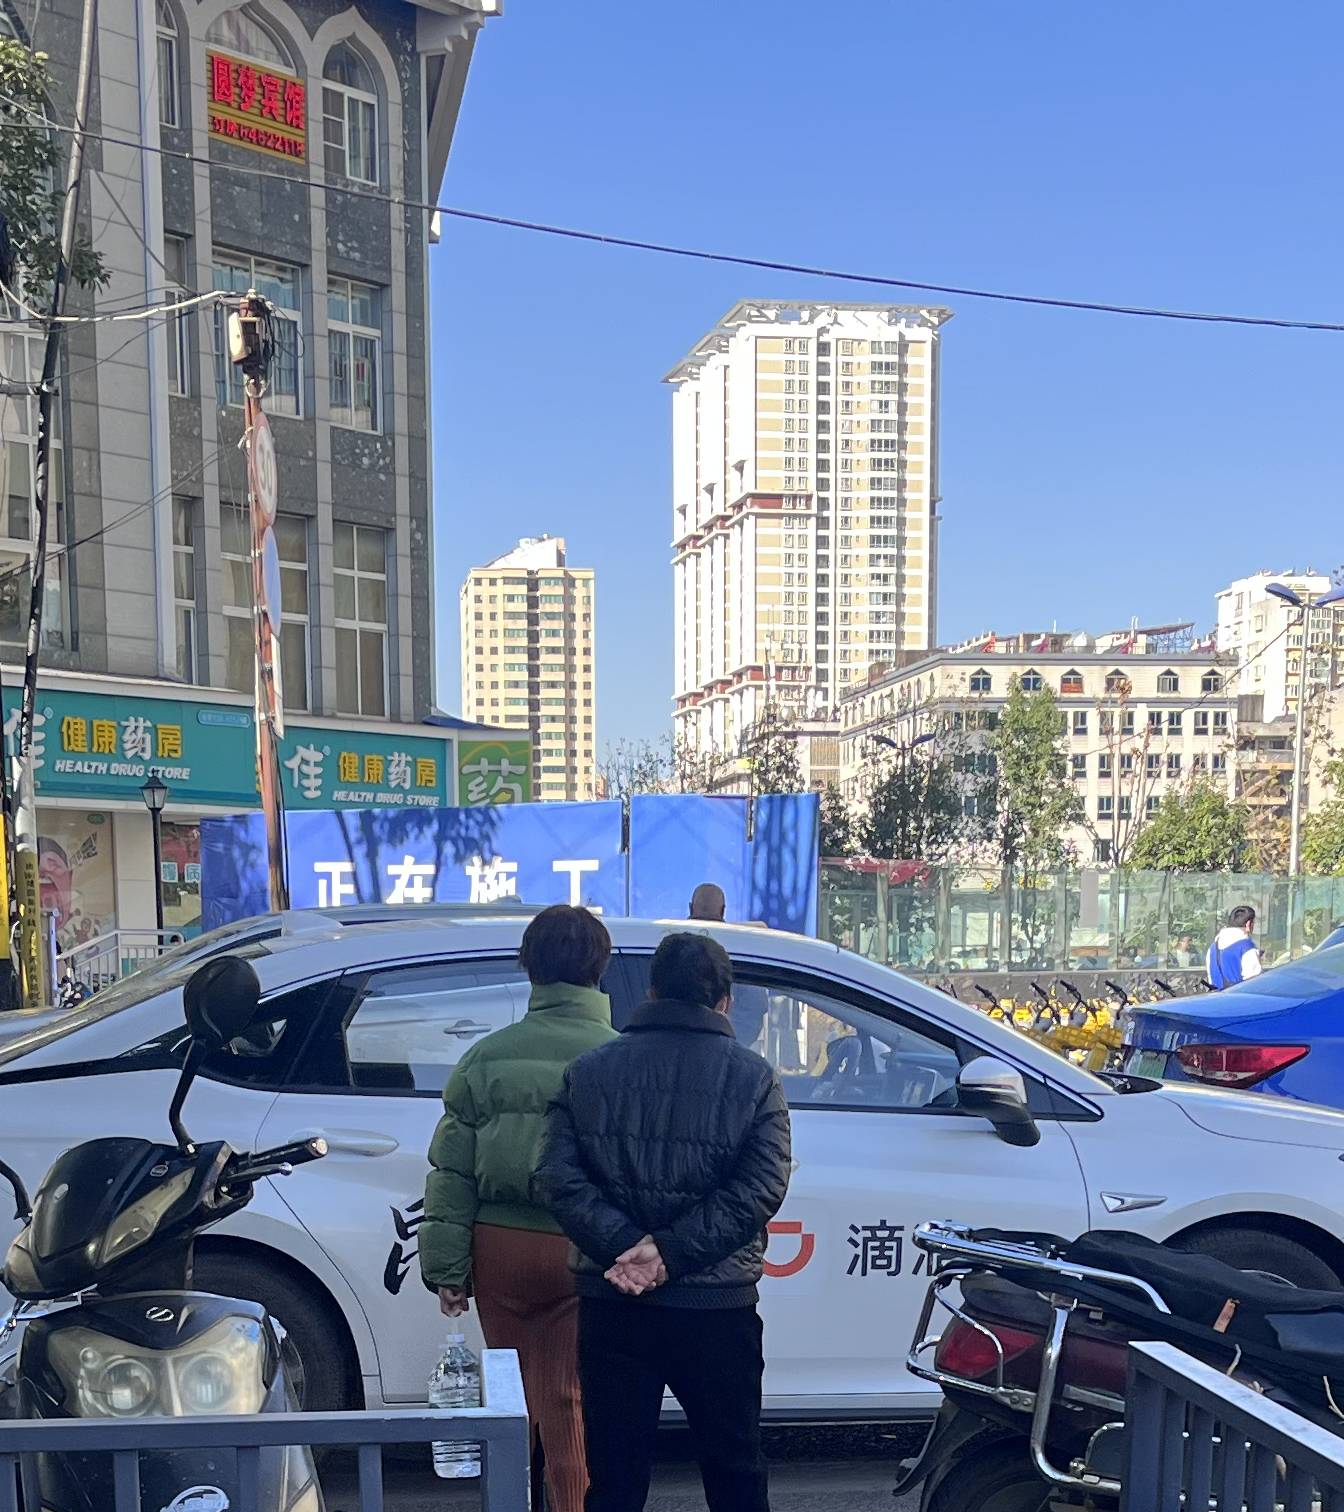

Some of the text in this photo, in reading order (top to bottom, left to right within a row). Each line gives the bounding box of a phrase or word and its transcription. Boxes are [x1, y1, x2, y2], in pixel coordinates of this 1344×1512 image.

[61, 716, 184, 761] 健康药房
[54, 759, 191, 780] HEALTH DRUG STORE
[284, 744, 325, 799] 佳
[338, 751, 437, 790] 健康药房
[462, 758, 528, 806] 药
[333, 790, 440, 807] HEALTH DRUG STORE
[314, 855, 603, 912] 正在施工
